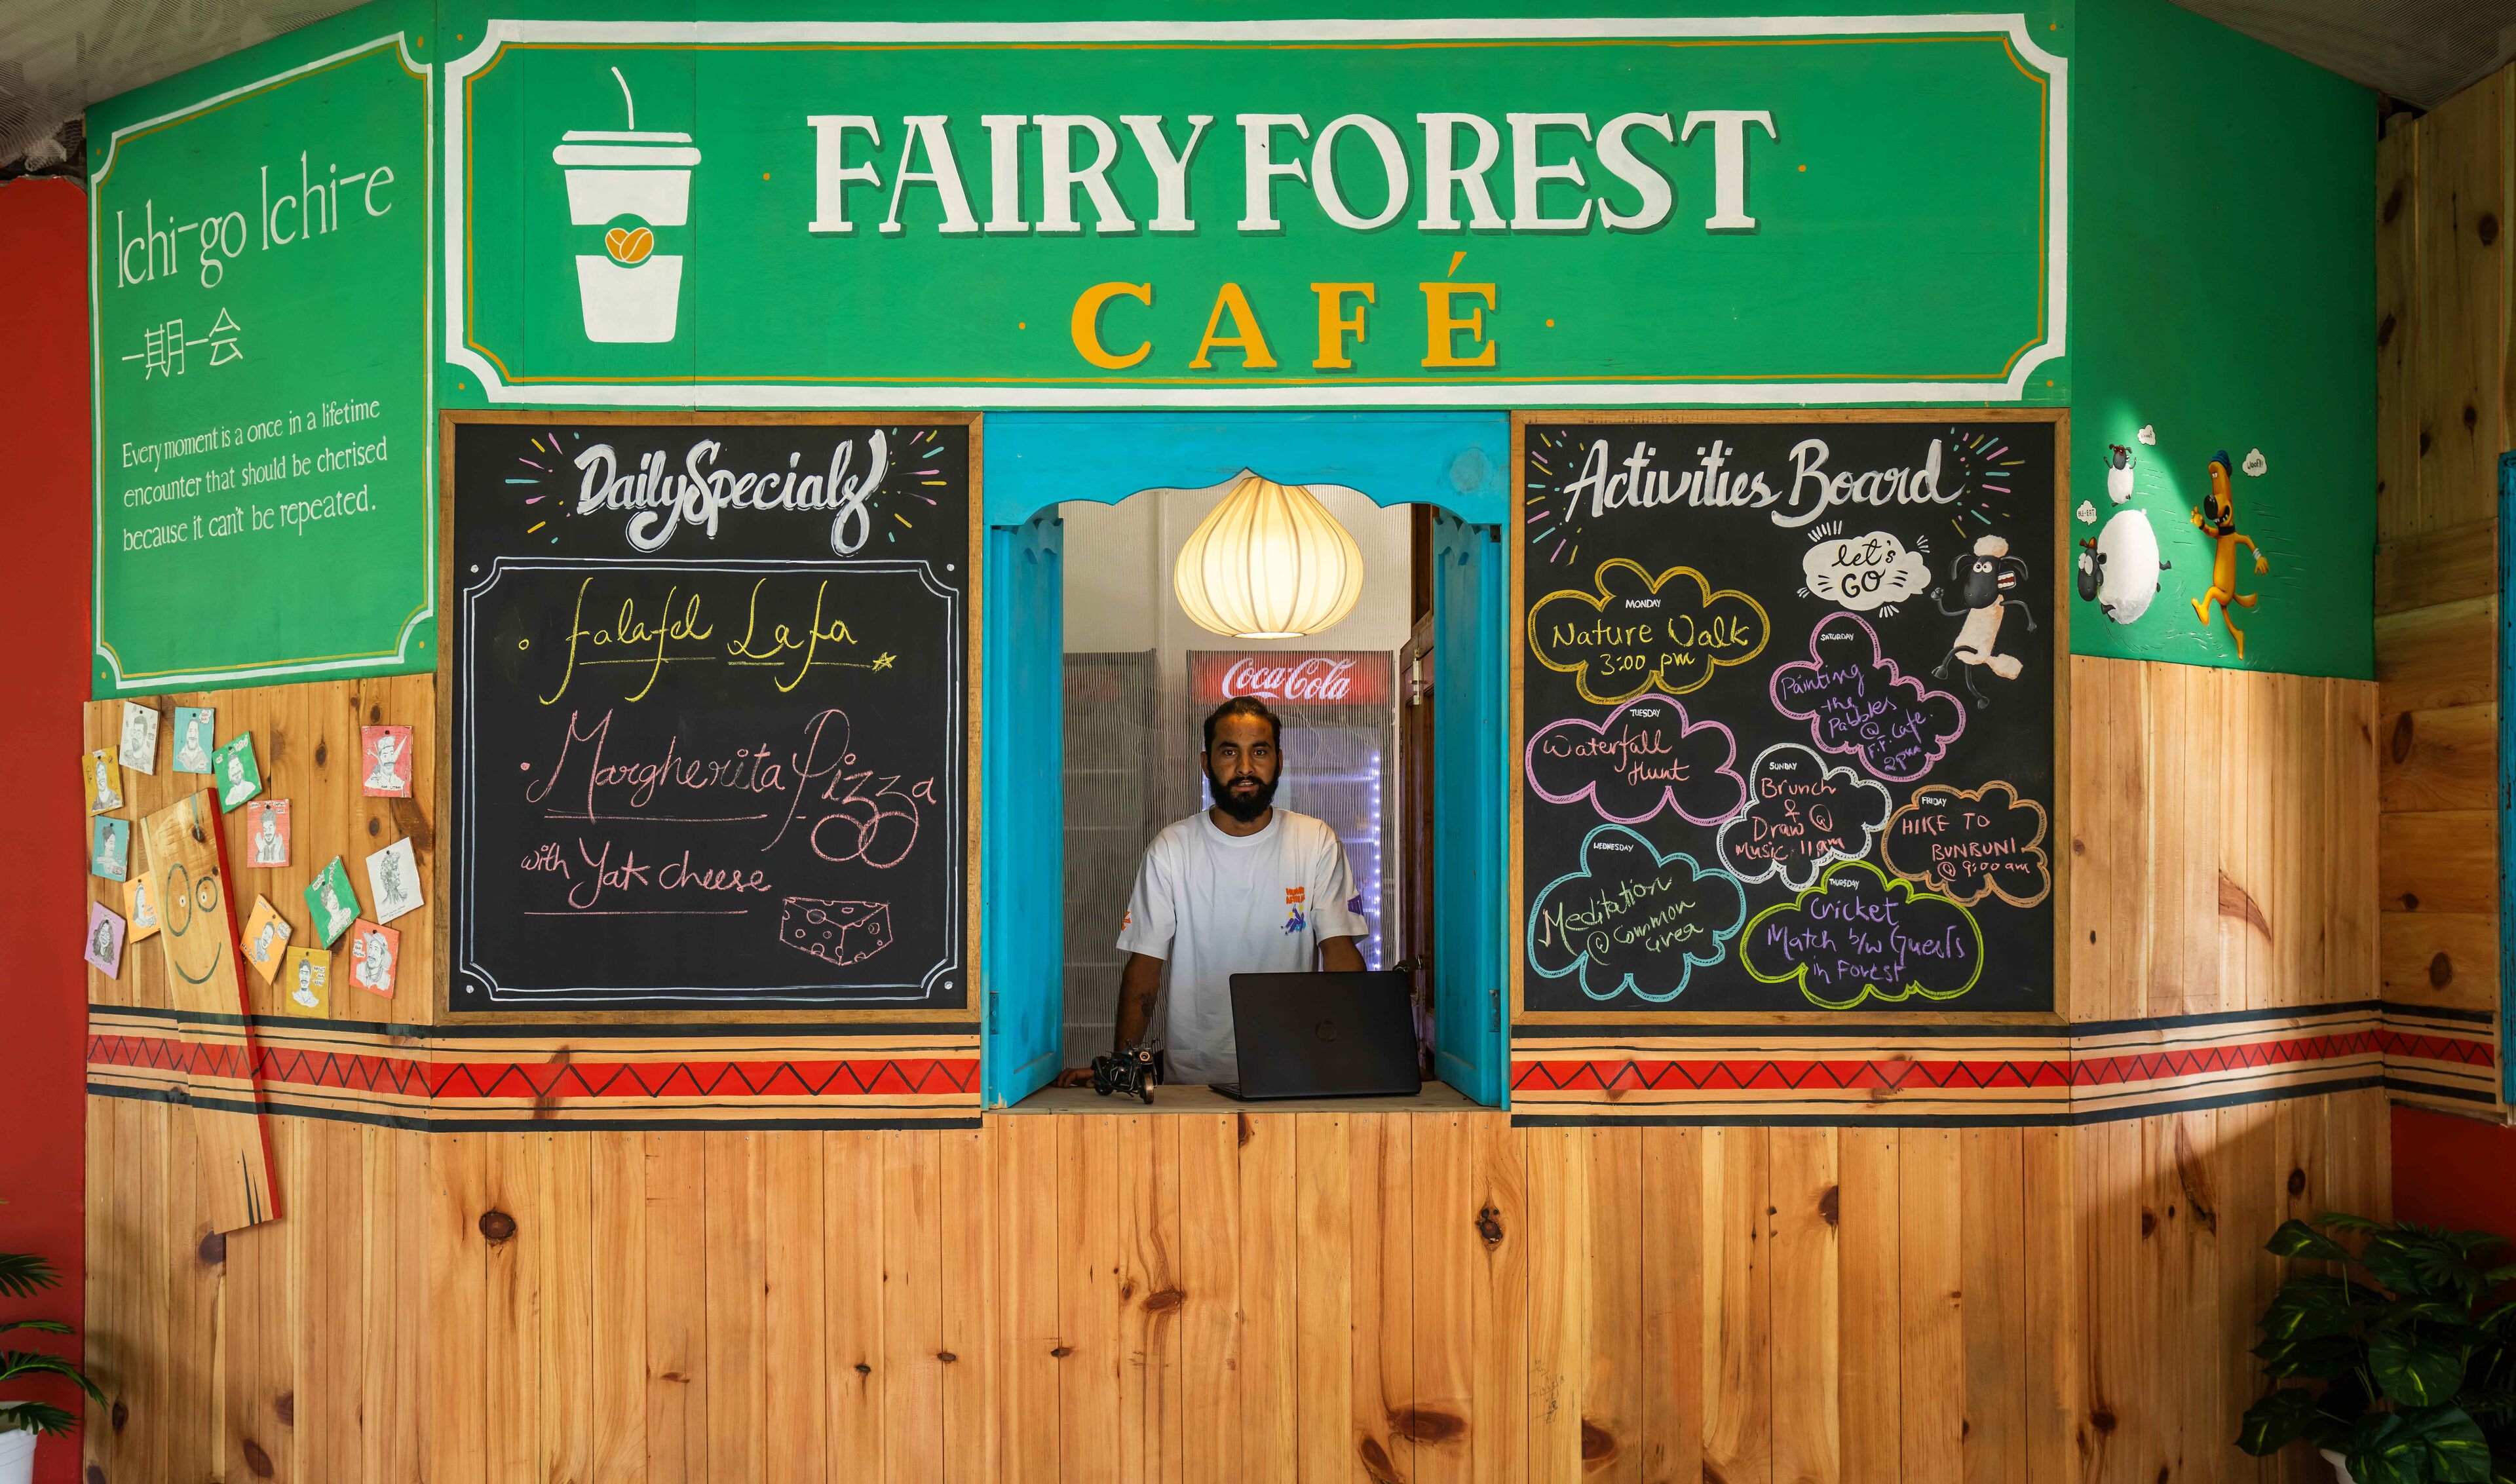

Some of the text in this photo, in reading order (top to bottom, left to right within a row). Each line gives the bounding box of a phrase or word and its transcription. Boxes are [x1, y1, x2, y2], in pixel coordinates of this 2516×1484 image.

[807, 109, 1778, 235] FAIRY FOREST
[116, 149, 394, 288] Ichi-go Ichi-e
[1071, 250, 1500, 371] CAFÉ
[122, 307, 243, 380] 一期一会
[123, 399, 381, 472] Every moment is a once in a lifetime
[124, 436, 388, 508] encounter that should be cherised
[1563, 438, 1965, 527] Activities Board
[573, 428, 888, 557] Daily Specials
[123, 520, 188, 552] because
[193, 515, 203, 541] it
[252, 504, 275, 531] be
[280, 484, 377, 536] repeated.
[1842, 567, 1886, 595] GO
[1626, 599, 1661, 609] MONDAY
[1552, 619, 1653, 648] Nature
[1222, 657, 1357, 700] Coca-Cola
[1600, 653, 1696, 677] 3:00 pm
[1781, 664, 1865, 700] Painting
[1630, 708, 1661, 717] TUESDAY
[1821, 696, 1858, 713] the
[1860, 722, 1879, 740] @
[1543, 724, 1673, 772] Waterfall
[1769, 761, 1797, 771] SUNDAY
[526, 708, 938, 869] Margherita Pizza
[1761, 777, 1836, 799] Brunch
[1922, 797, 1947, 807] FRIDAY
[1751, 803, 1833, 843] Draw @
[1902, 812, 1991, 835] HIKE TO
[1593, 842, 1634, 852] WEDNESDAY
[1932, 837, 2015, 862] BUNBUNI
[521, 841, 571, 879] with
[567, 837, 651, 909] Yak
[1829, 878, 1859, 890] THURSDAY
[1937, 861, 1956, 882] @
[2005, 863, 2030, 874] am
[1538, 877, 1673, 957] Meditation
[1810, 896, 1899, 926] Cricket
[1587, 930, 1611, 966] @
[1645, 923, 1704, 953] area
[1768, 924, 1837, 961] Match
[1849, 928, 1882, 955] b/w
[1813, 955, 1905, 983] in Forest
